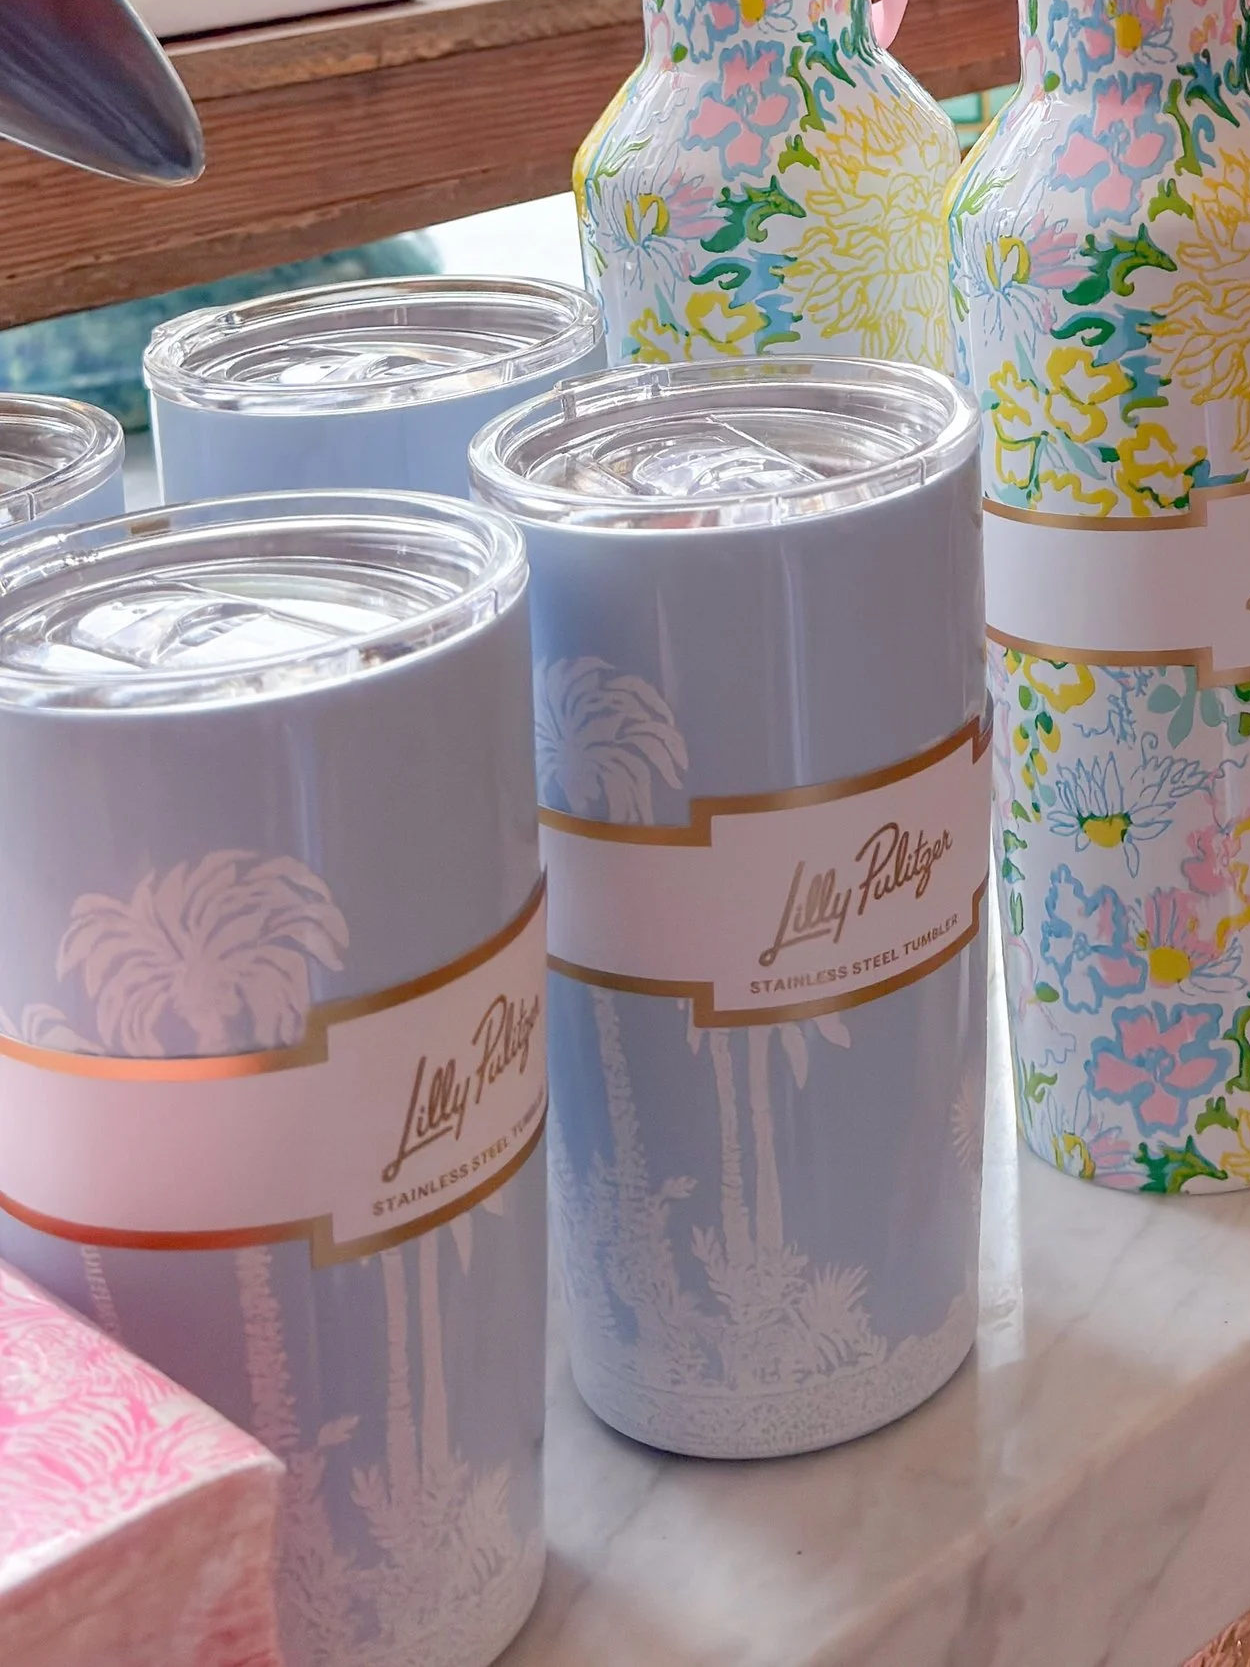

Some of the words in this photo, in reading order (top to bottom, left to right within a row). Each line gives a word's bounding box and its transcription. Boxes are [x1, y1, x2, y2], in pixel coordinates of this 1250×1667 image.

[757, 860, 853, 968] Lilly
[854, 820, 954, 917] Pulitzer
[749, 965, 849, 995] STAINLESS
[851, 948, 900, 976] STEEL
[902, 913, 959, 957] TUMBLER
[381, 1054, 472, 1184] Lilly
[370, 1163, 470, 1218] STAINLESS
[470, 1136, 510, 1176] STEEL
